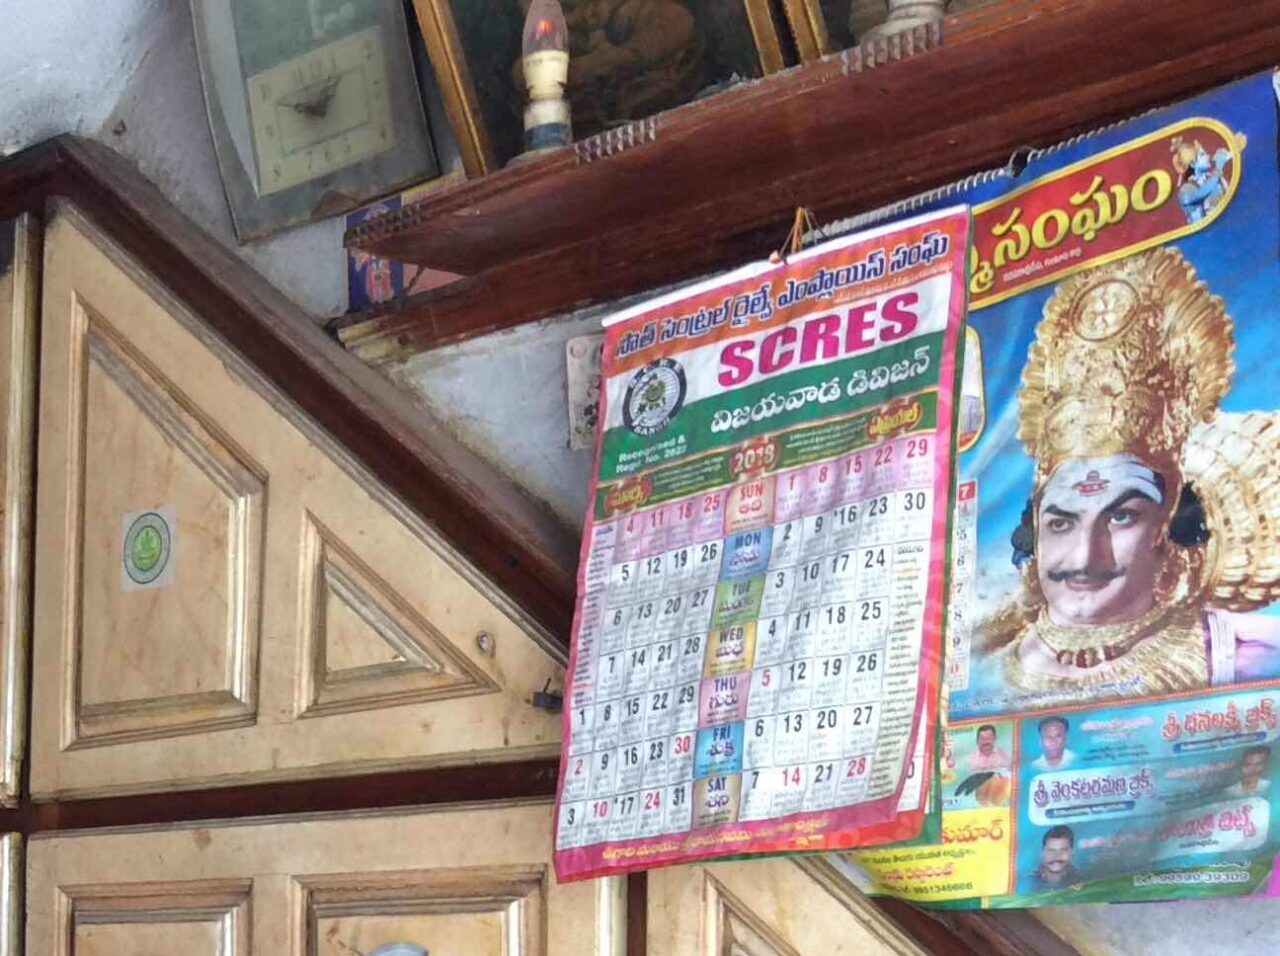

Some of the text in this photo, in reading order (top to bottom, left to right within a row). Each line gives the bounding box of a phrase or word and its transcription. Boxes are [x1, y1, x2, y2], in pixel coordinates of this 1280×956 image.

[718, 292, 919, 387] SCRES
[711, 345, 930, 433] విజయవాడ డివిజన్
[651, 511, 664, 527] 11
[704, 495, 720, 513] 25
[740, 484, 764, 499] SUN
[845, 455, 862, 475] 15
[874, 446, 893, 467] 22
[907, 438, 928, 459] 29
[732, 443, 775, 474] 2018
[647, 557, 661, 576] 12
[674, 550, 688, 568] 19
[701, 543, 717, 562] 26
[735, 532, 761, 547] MON
[869, 496, 888, 517] 23
[904, 492, 926, 512] 30
[638, 603, 653, 620] 13
[664, 597, 681, 614] 20
[691, 590, 709, 608] 27
[802, 562, 820, 582] 10
[832, 554, 849, 574] 17
[865, 548, 886, 569] 24
[631, 651, 645, 668] 14
[657, 644, 672, 662] 21
[684, 637, 701, 656] 28
[720, 627, 744, 643] WED
[795, 612, 811, 631] 11
[826, 606, 846, 625] 18
[861, 601, 881, 620] 25
[627, 698, 640, 716] 15
[652, 692, 668, 711] 22
[678, 686, 695, 705] 29
[714, 677, 738, 692] THU
[790, 662, 807, 682] 12
[823, 658, 842, 677] 19
[856, 653, 878, 673] 26
[624, 747, 638, 766] 16
[649, 741, 664, 761] 23
[675, 735, 691, 755] 30
[713, 726, 732, 741] FRI
[784, 714, 803, 733] 13
[816, 709, 837, 729] 20
[853, 706, 874, 726] 27
[593, 801, 607, 818] 10
[644, 792, 660, 810] 24
[673, 788, 685, 806] 31
[707, 777, 728, 793] SAT
[782, 767, 801, 786] 14
[815, 764, 833, 783] 21
[847, 758, 867, 777] 28
